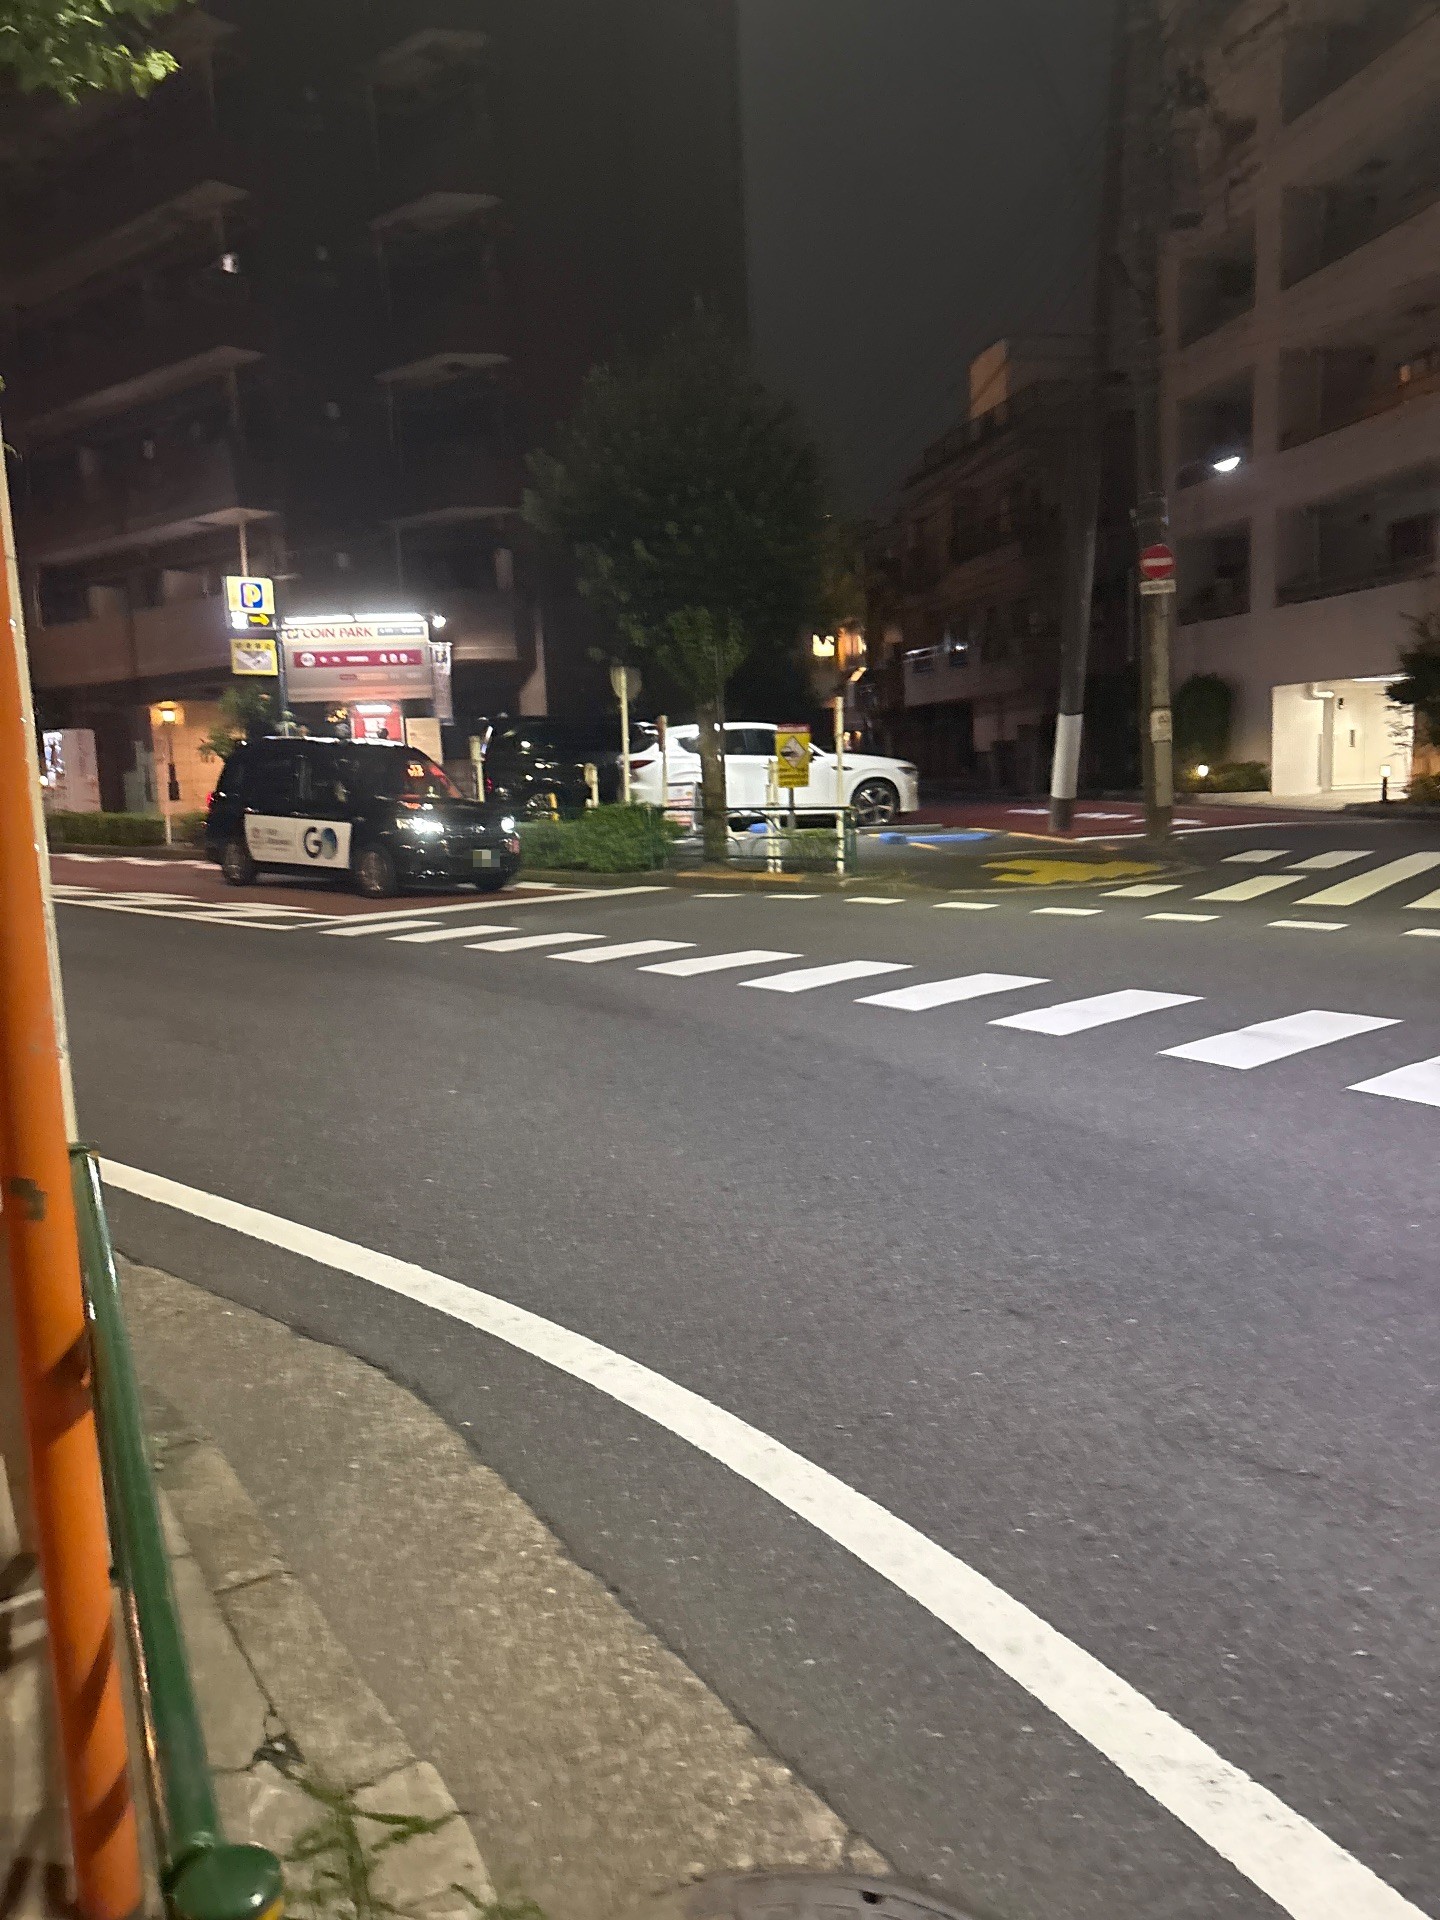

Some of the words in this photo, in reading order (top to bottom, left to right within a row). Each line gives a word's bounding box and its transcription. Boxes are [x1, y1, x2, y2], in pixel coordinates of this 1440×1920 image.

[243, 584, 261, 608] P
[302, 628, 336, 639] COIN
[339, 626, 373, 638] PARK
[303, 826, 338, 860] GO
